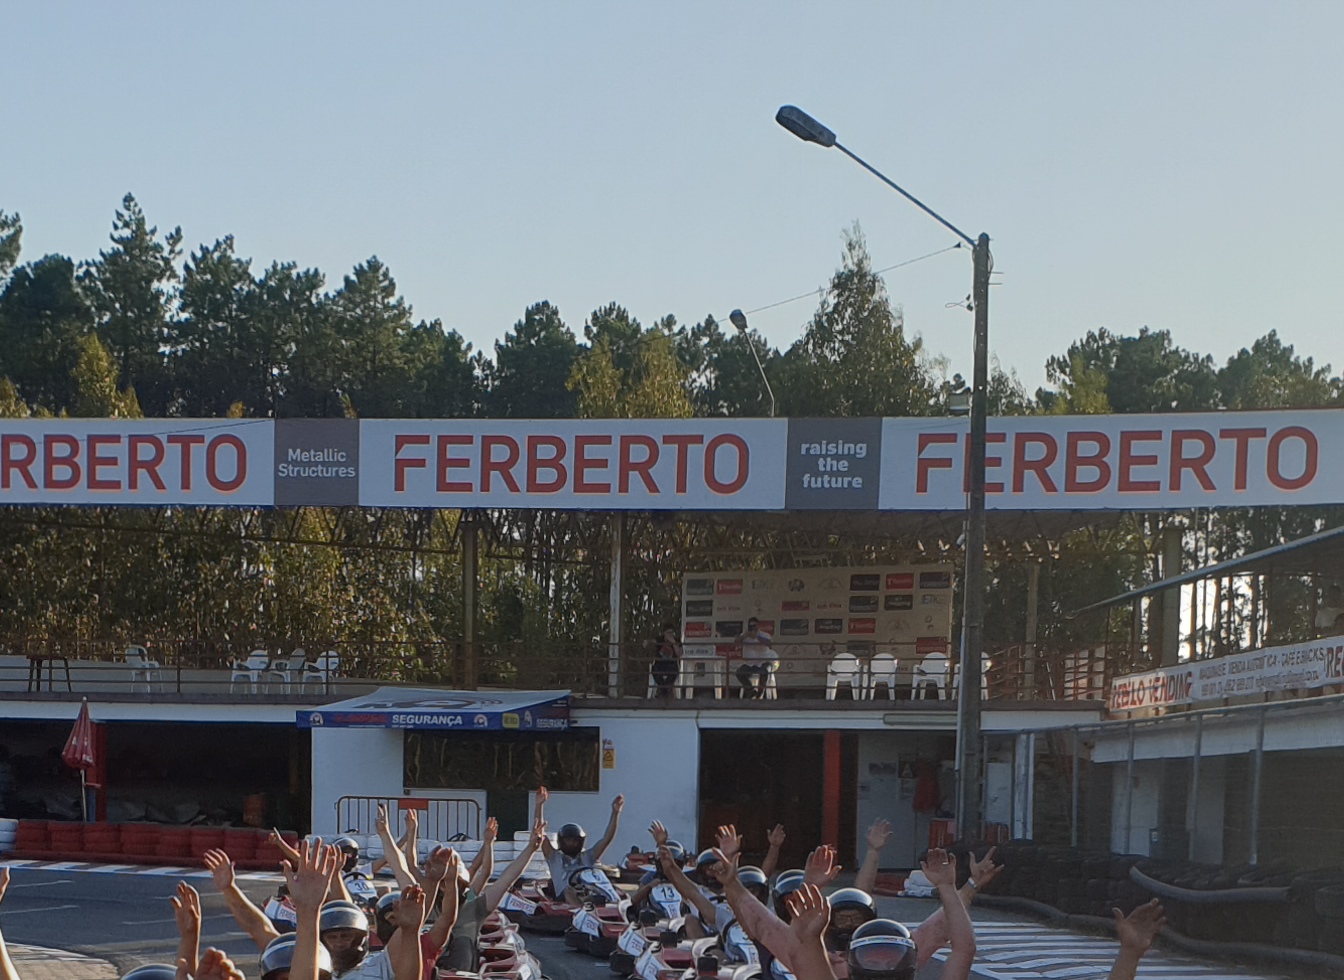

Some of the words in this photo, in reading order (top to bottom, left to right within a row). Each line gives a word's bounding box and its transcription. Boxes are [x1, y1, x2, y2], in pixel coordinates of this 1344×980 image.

[286, 447, 348, 465] Metallic
[799, 440, 869, 460] raising
[393, 432, 751, 496] FERBERTO
[816, 456, 849, 472] the
[914, 426, 1320, 494] FERBERTO
[277, 462, 356, 480] Structures
[801, 473, 864, 489] future
[391, 714, 463, 728] SEGURANÇA
[354, 882, 369, 891] 30
[660, 887, 676, 900] 13
